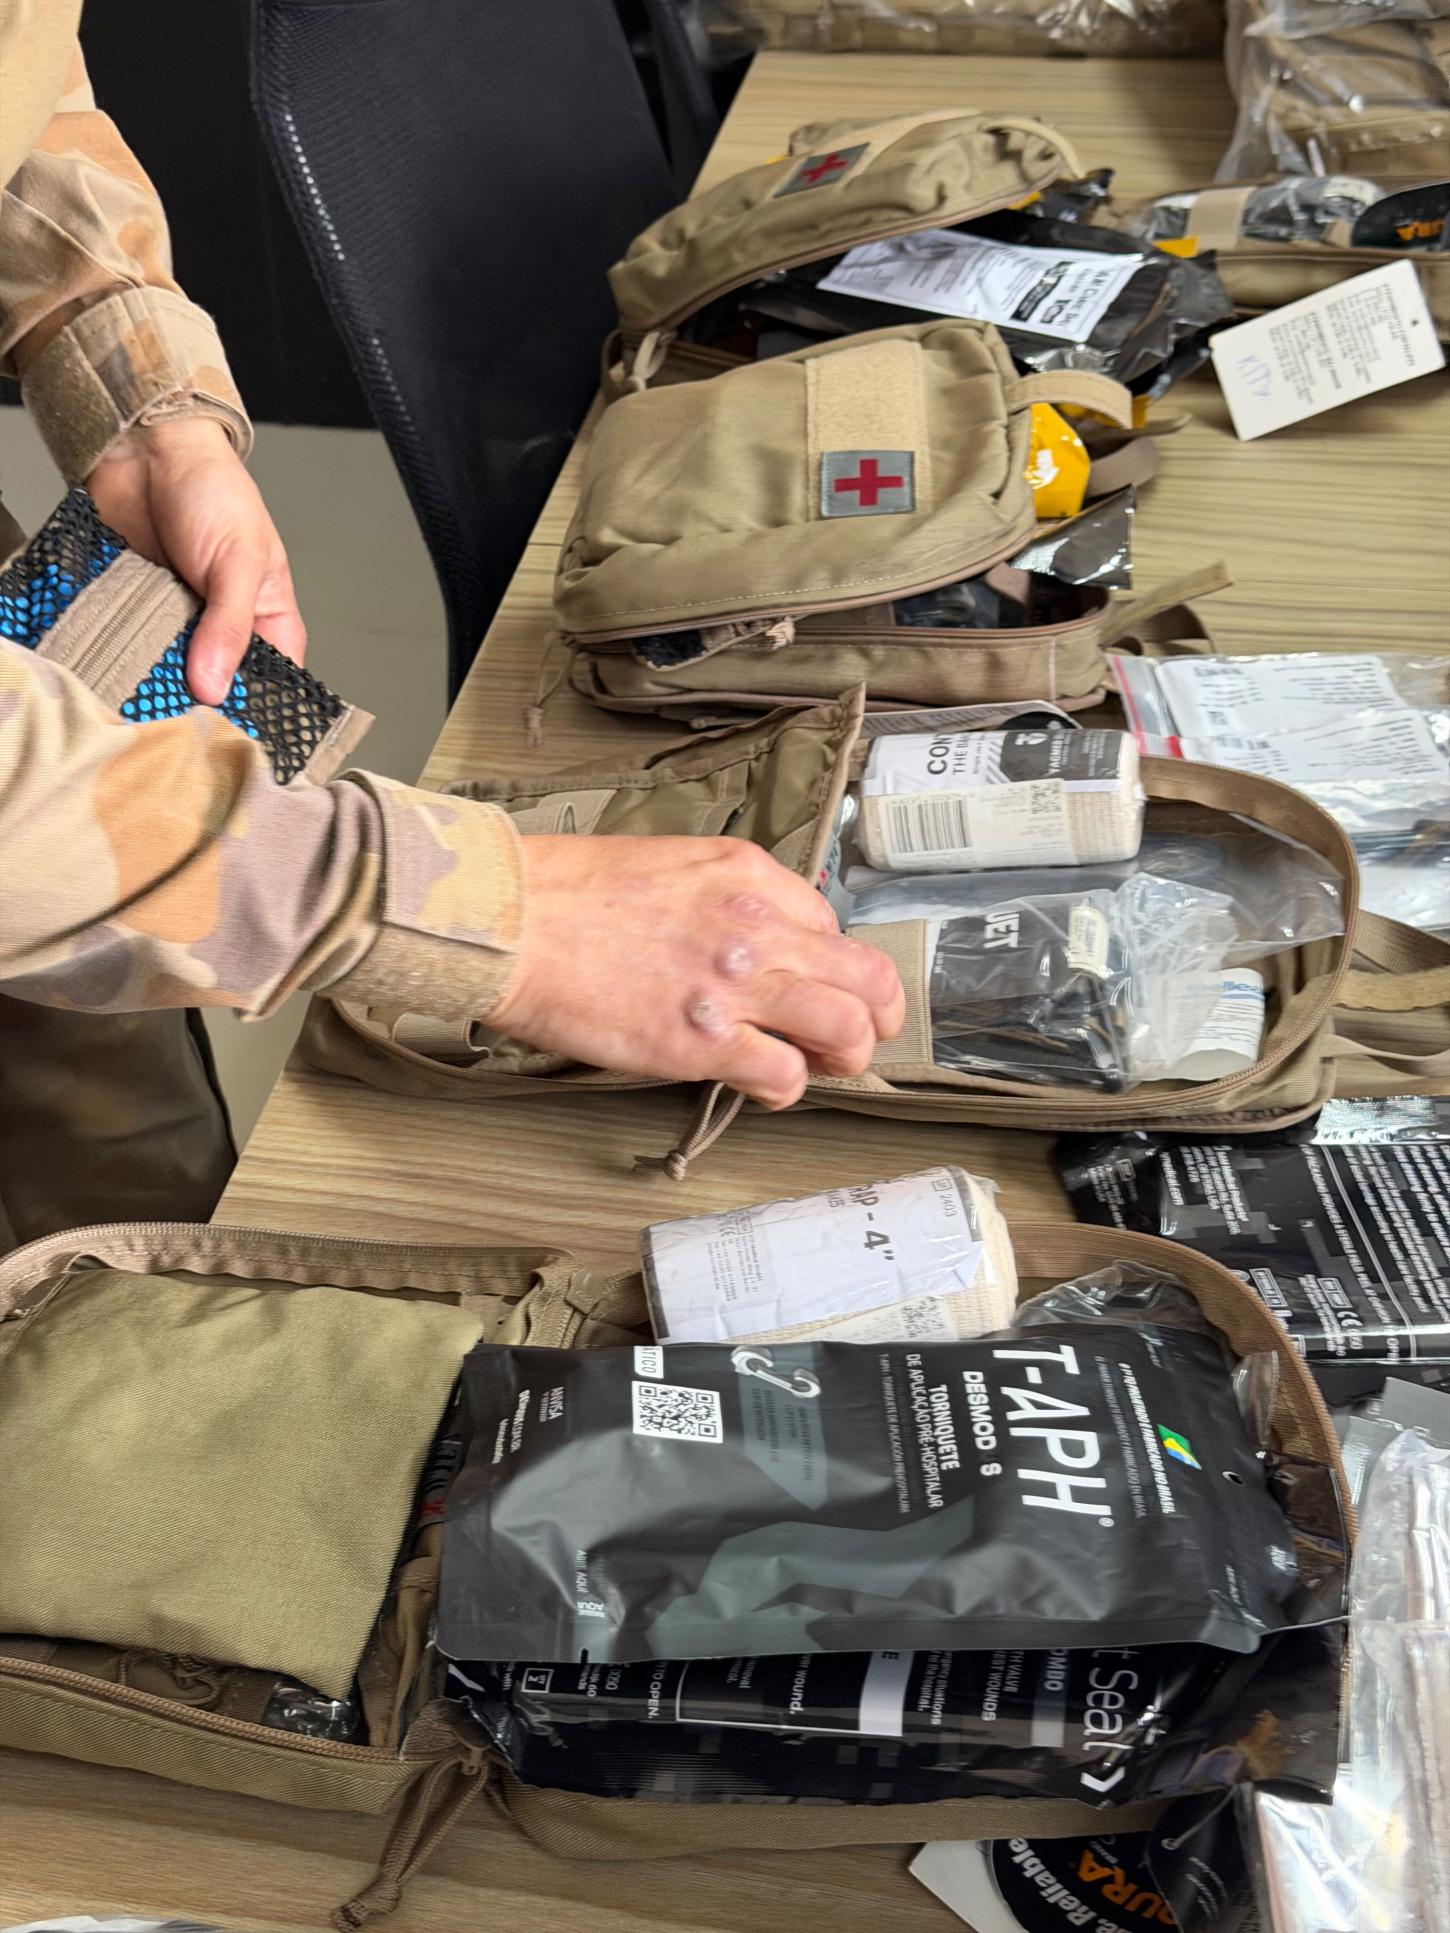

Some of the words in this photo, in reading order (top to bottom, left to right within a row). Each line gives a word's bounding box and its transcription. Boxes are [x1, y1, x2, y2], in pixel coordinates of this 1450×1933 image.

[848, 1184, 879, 1206] RAP
[940, 1193, 957, 1217] 2403
[905, 1353, 922, 1367] DE
[548, 1386, 565, 1420] ANVISA
[882, 1376, 900, 1414] TORNIQUETE
[909, 1369, 932, 1423] APLICAÇÃO
[1125, 1383, 1150, 1422] PROJETADO
[929, 1384, 960, 1470] TORNIQUETE
[962, 1371, 1003, 1476] DESMODS
[915, 1424, 944, 1507] PRÉ-HOSPITALAR
[1140, 1428, 1165, 1470] FABRICADO
[1153, 1470, 1167, 1484] NO
[1156, 1484, 1176, 1514] BRASIL
[1004, 1664, 1021, 1692] VALVE
[1044, 1650, 1068, 1691] OMBO
[647, 1682, 663, 1719] OPEN.
[789, 1670, 807, 1714] wound.
[917, 1675, 935, 1712] hospital.
[931, 1679, 948, 1725] situations
[981, 1672, 1003, 1721] WOUNDS
[1082, 1667, 1139, 1751] Seal
[1009, 1836, 1097, 1928] Reliable
